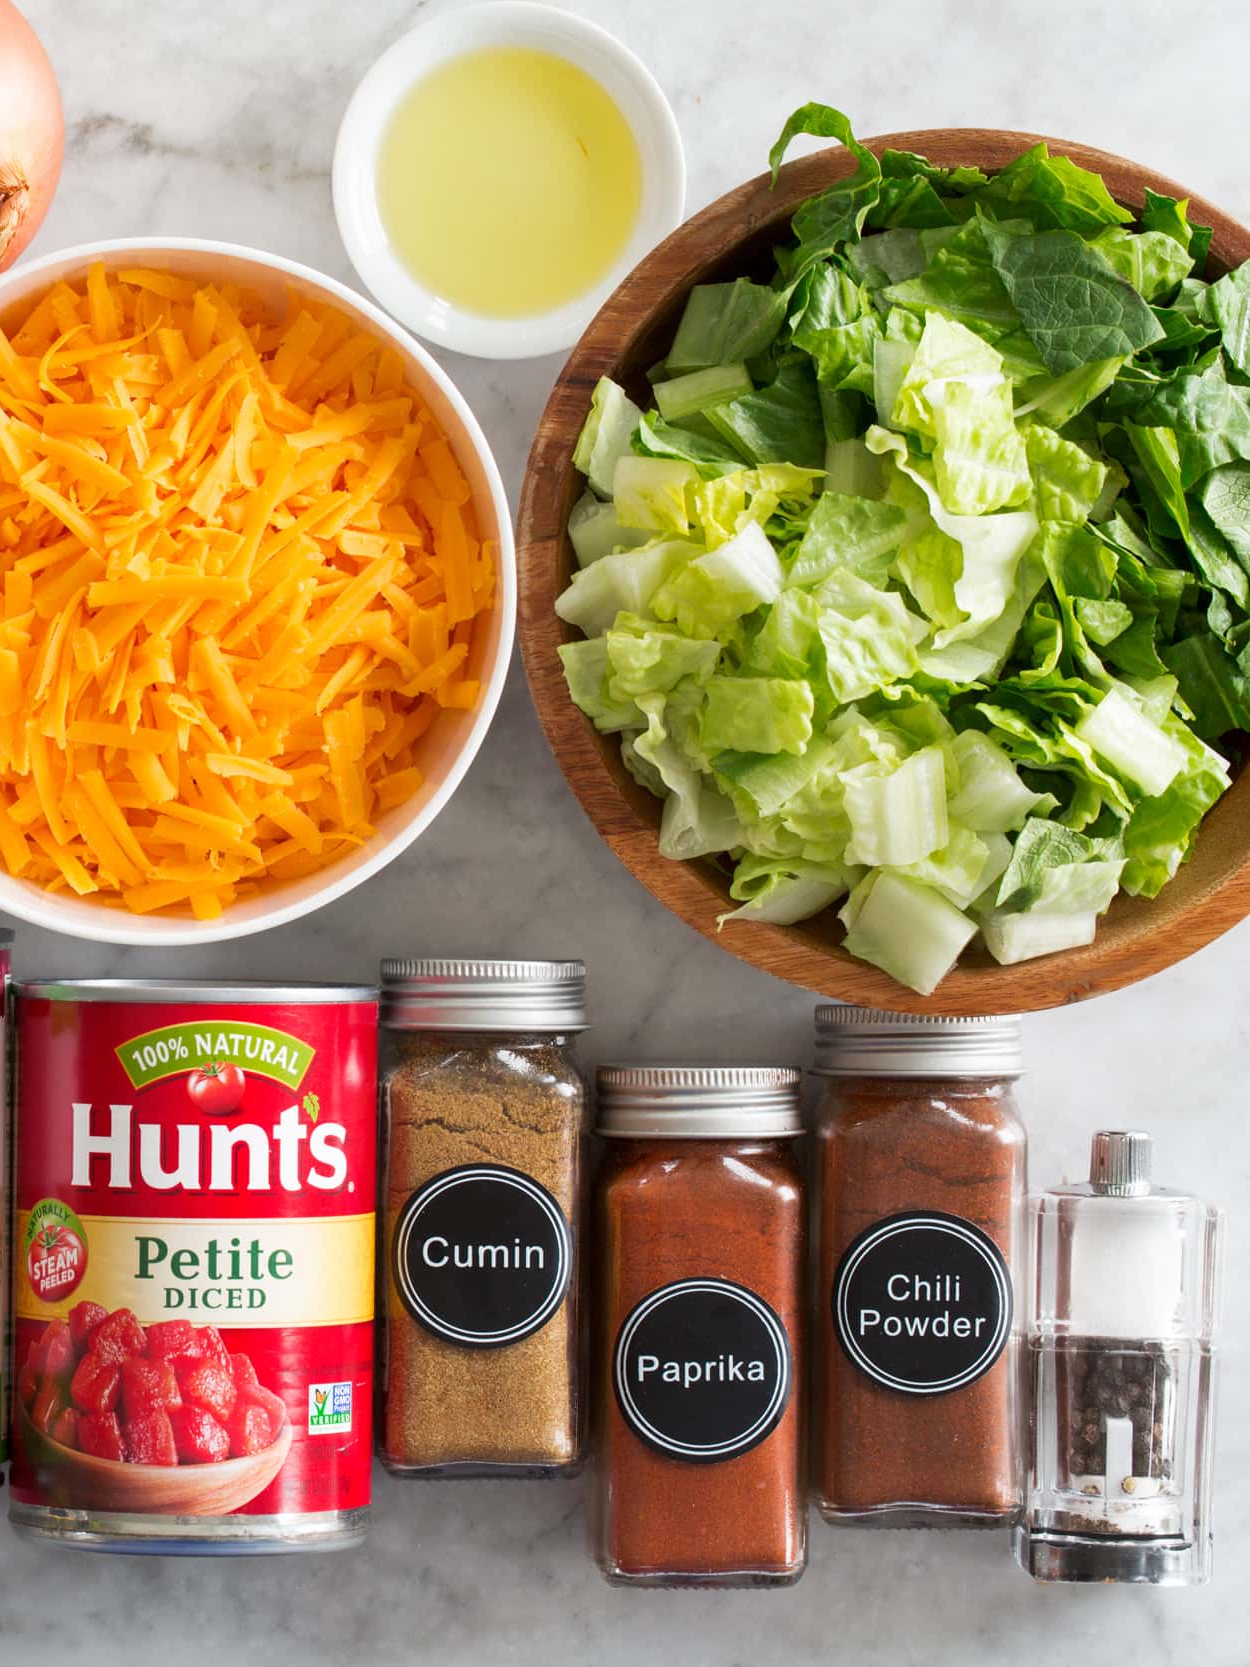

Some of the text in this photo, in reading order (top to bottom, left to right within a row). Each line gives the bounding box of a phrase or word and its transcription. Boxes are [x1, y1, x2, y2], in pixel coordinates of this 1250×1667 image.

[132, 1033, 299, 1075] 100% NATURAL
[27, 1204, 70, 1238] NATURALLY
[34, 1247, 78, 1281] STEAM
[134, 1236, 293, 1280] Petite
[423, 1237, 544, 1269] Cumin
[40, 1268, 76, 1293] PEELED
[887, 1274, 961, 1302] Chili
[163, 1287, 267, 1309] DICED
[859, 1310, 986, 1340] Powder
[636, 1354, 765, 1388] Paprika
[310, 1413, 350, 1425] VERIFIED
